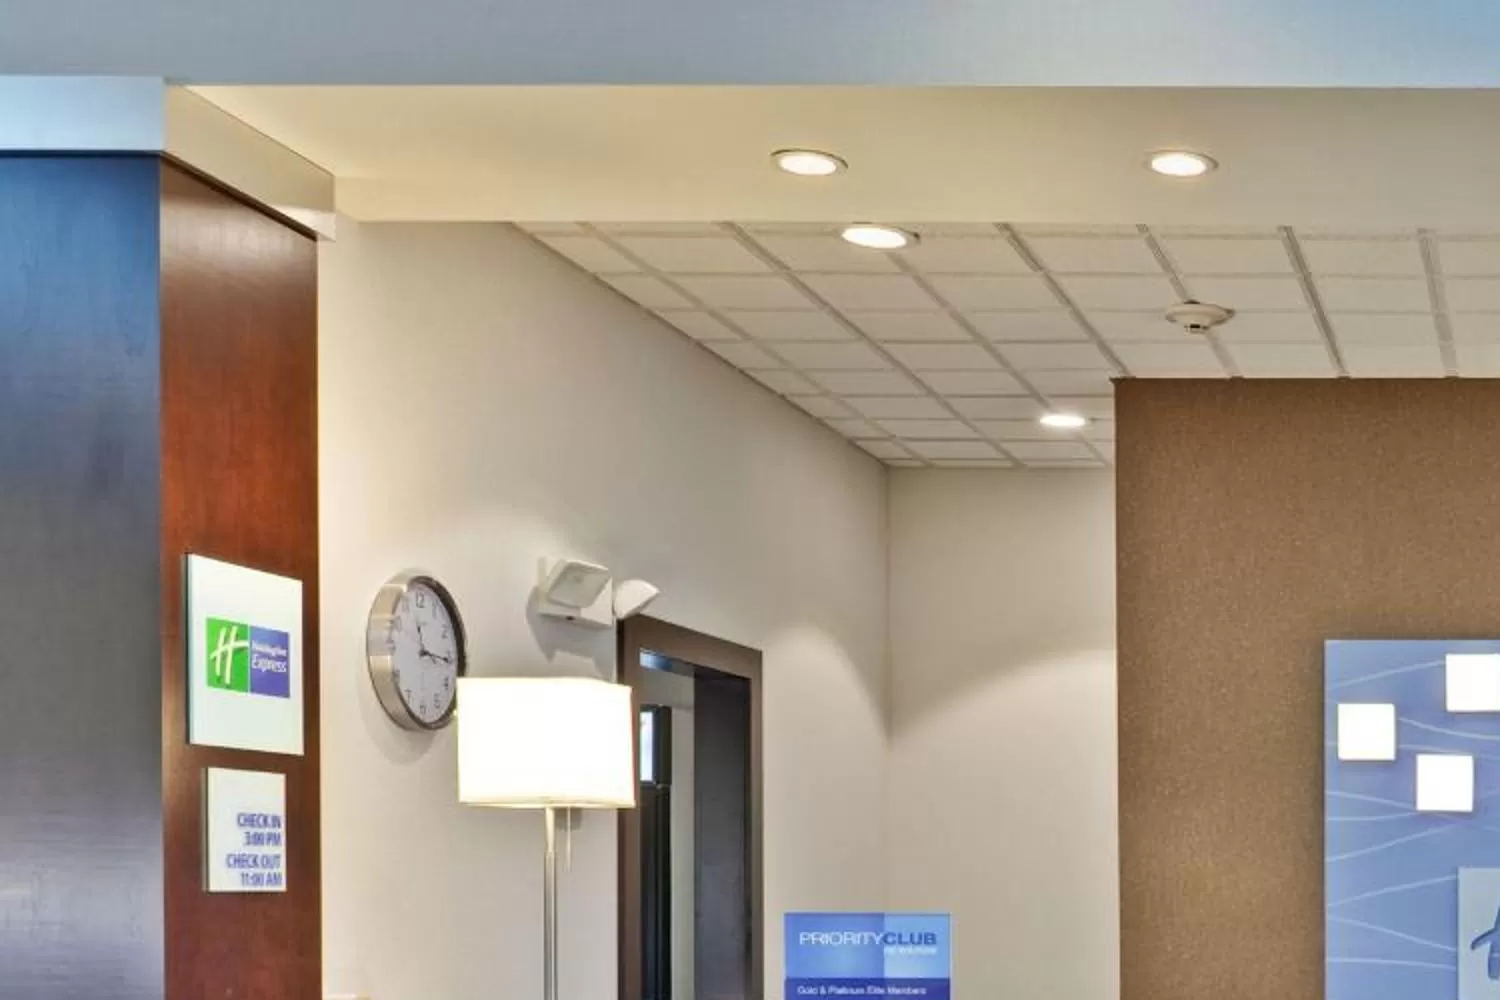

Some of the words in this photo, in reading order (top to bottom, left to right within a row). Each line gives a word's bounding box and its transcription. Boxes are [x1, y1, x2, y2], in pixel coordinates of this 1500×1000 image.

[251, 654, 287, 673] Express
[237, 812, 270, 828] CHECK
[271, 815, 282, 829] IN
[244, 831, 264, 846] 3:00
[265, 832, 282, 846] PM
[226, 853, 260, 868] CHECK
[261, 854, 281, 869] OUT
[241, 872, 264, 887] 11:00
[266, 872, 283, 887] AM
[797, 984, 819, 995] Gold
[820, 984, 827, 995] &
[828, 984, 865, 995] Platinum
[867, 984, 885, 995] Elite
[887, 984, 927, 995] Members
